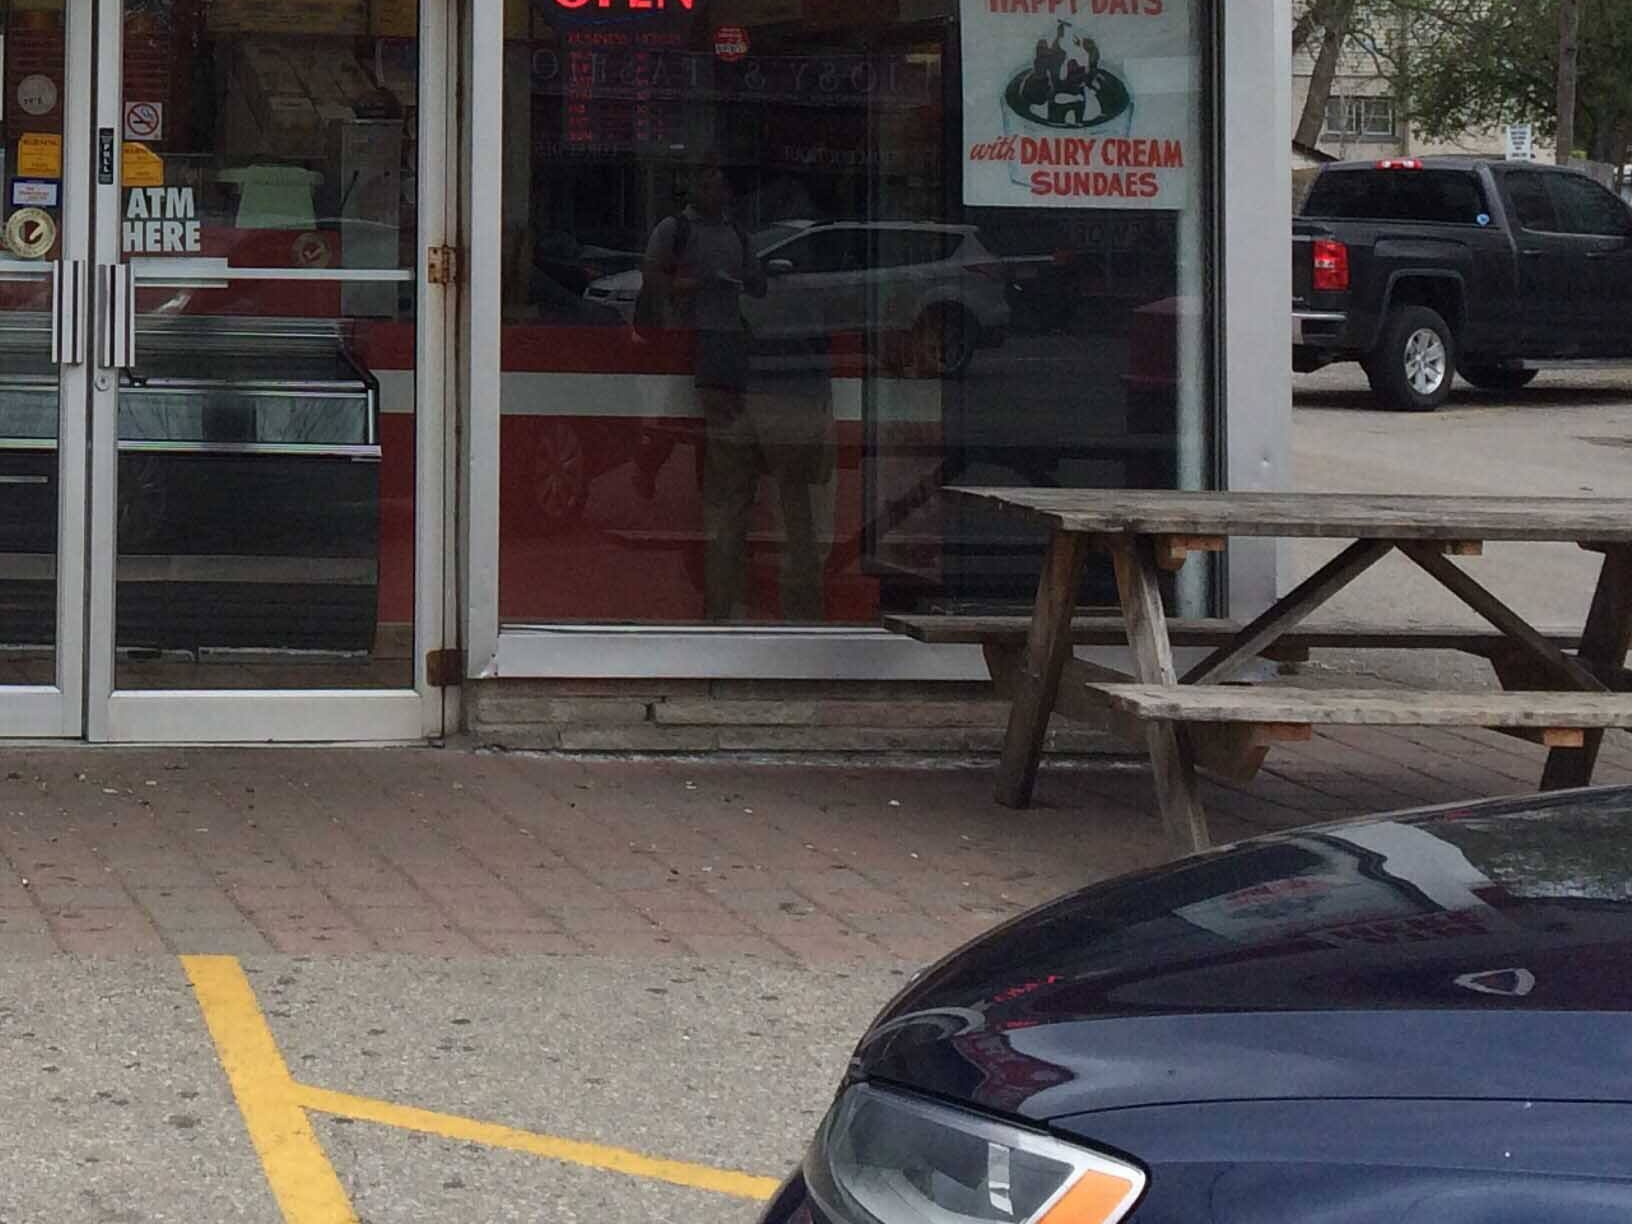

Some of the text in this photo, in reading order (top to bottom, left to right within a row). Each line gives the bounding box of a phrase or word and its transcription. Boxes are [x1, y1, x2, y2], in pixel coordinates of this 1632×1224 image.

[969, 134, 1018, 161] with
[1020, 136, 1097, 166] DAIRY
[1100, 138, 1185, 168] CREAM
[1030, 170, 1159, 198] SUNDAES
[126, 187, 195, 219] ATM
[122, 221, 201, 253] HERE
